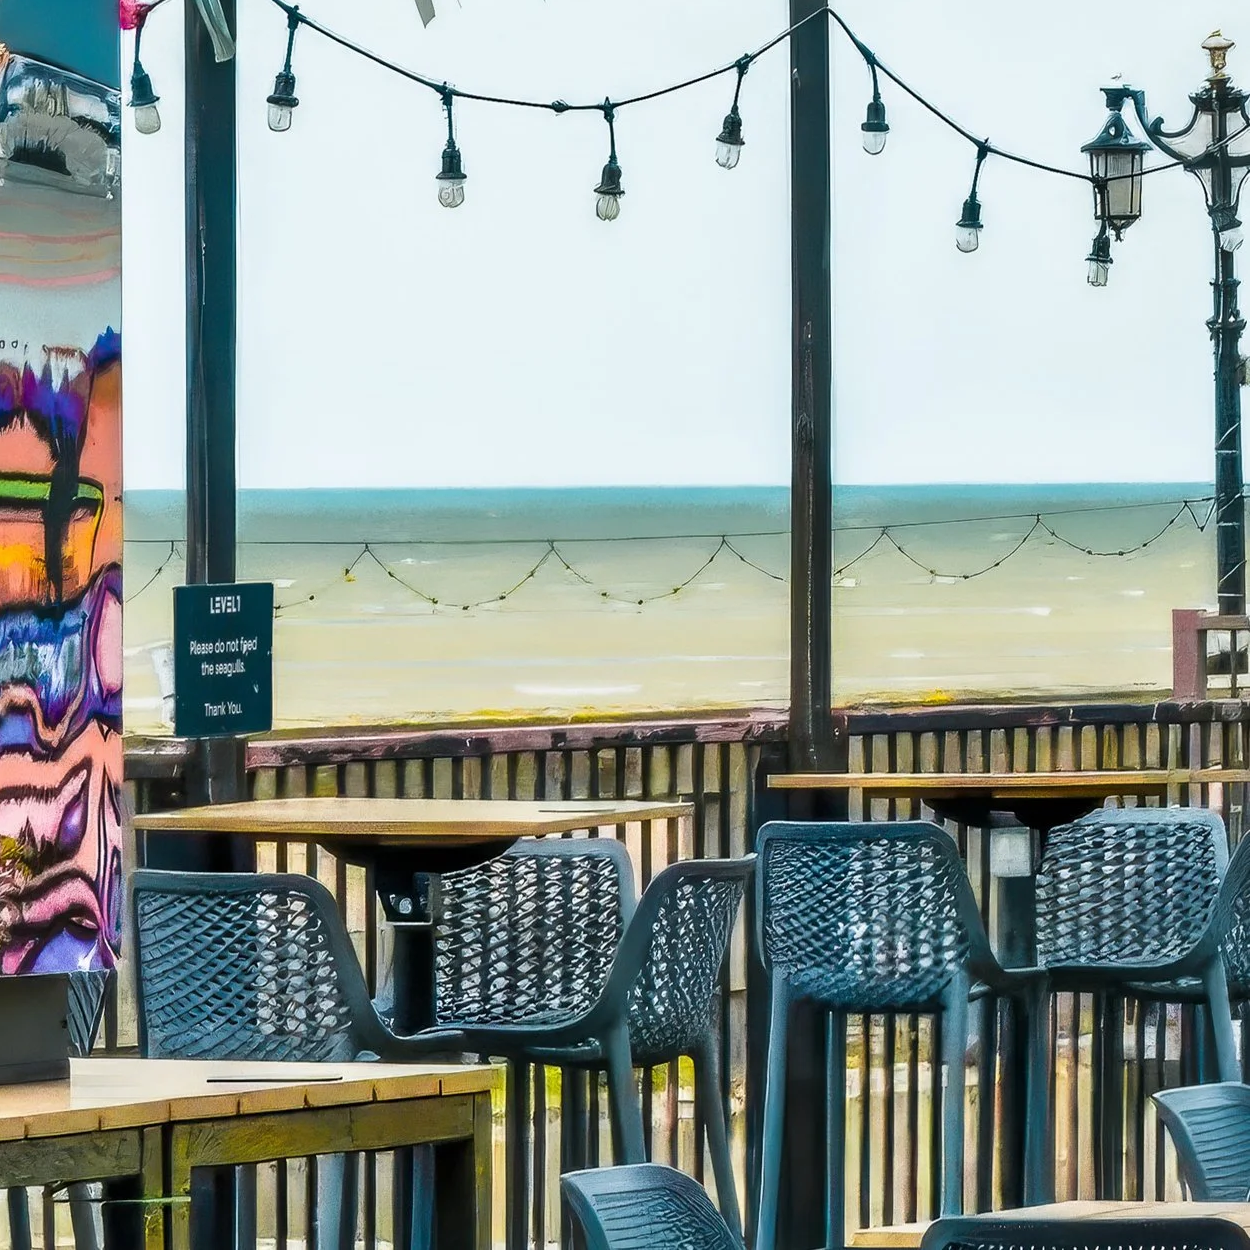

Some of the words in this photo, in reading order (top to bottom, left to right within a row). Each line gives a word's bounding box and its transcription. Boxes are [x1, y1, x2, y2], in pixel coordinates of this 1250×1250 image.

[190, 640, 214, 655] Please
[215, 638, 225, 653] do
[226, 638, 239, 653] not
[240, 636, 258, 652] feed
[201, 661, 214, 676] the
[215, 658, 246, 677] seagulls.
[205, 702, 226, 717] Thank
[227, 701, 242, 716] You.
